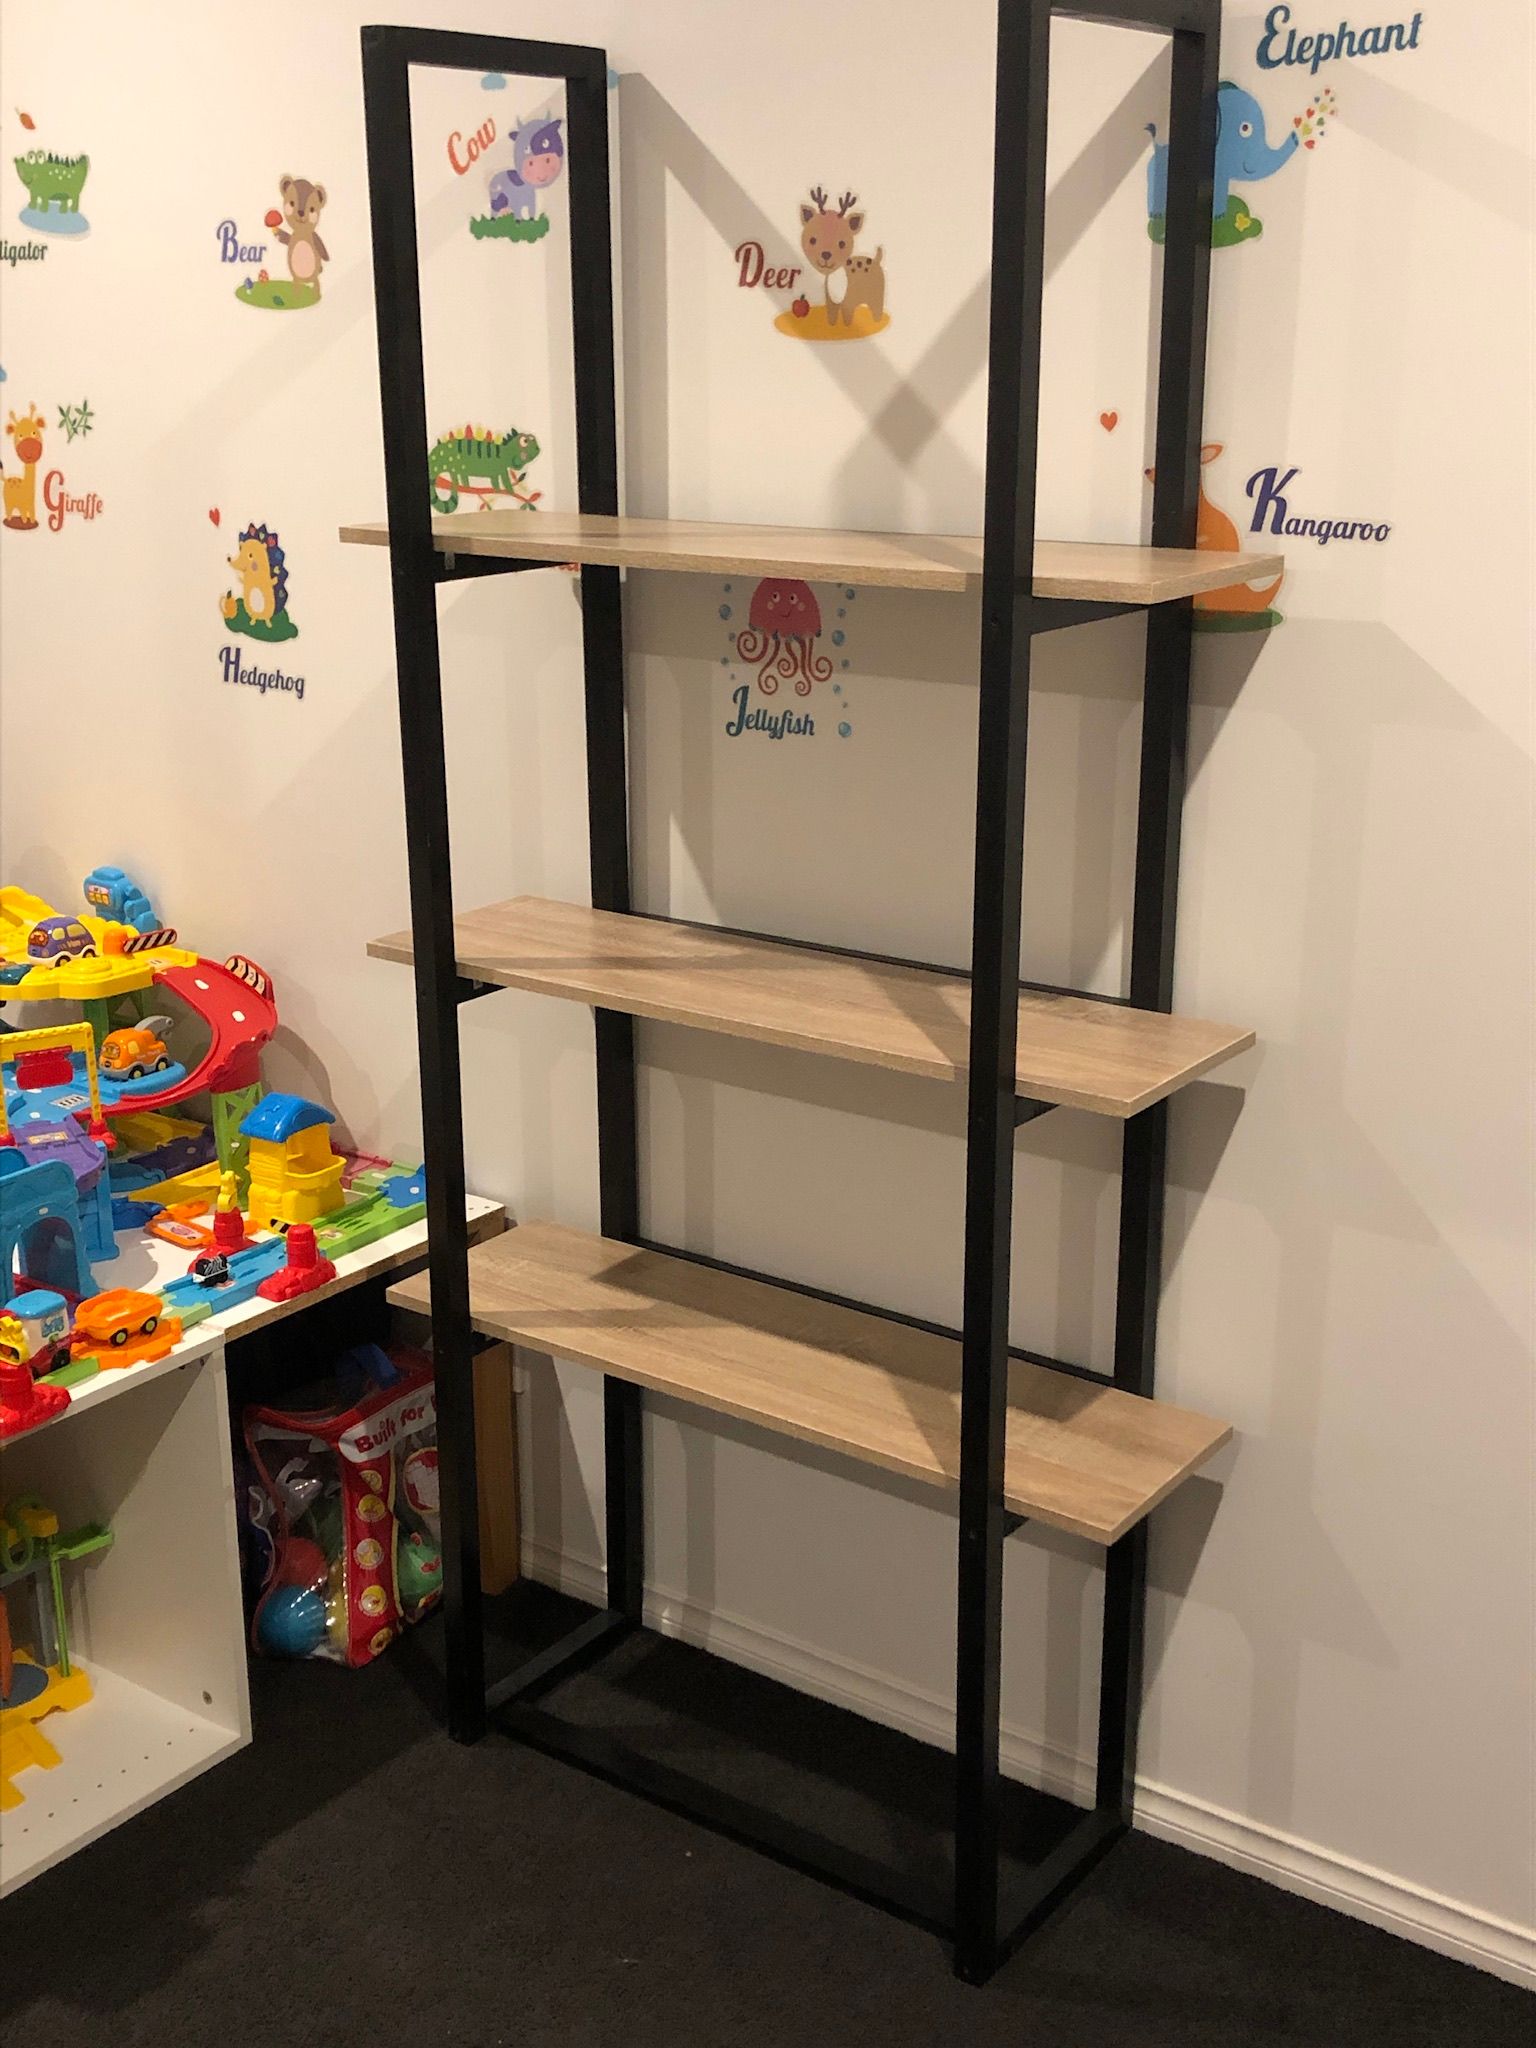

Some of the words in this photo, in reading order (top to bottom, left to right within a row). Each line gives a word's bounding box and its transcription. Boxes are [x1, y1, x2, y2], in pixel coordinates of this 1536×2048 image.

[1256, 5, 1422, 75] Elephant
[447, 117, 496, 175] Cow
[216, 219, 267, 263] Bear
[735, 241, 801, 289] Deer
[43, 470, 103, 533] Giraffe
[1245, 467, 1392, 545] Kangaroo
[218, 646, 305, 700] Hedgehog
[725, 684, 815, 740] Jellyfish
[354, 1417, 397, 1454] Built
[400, 1406, 425, 1428] for
